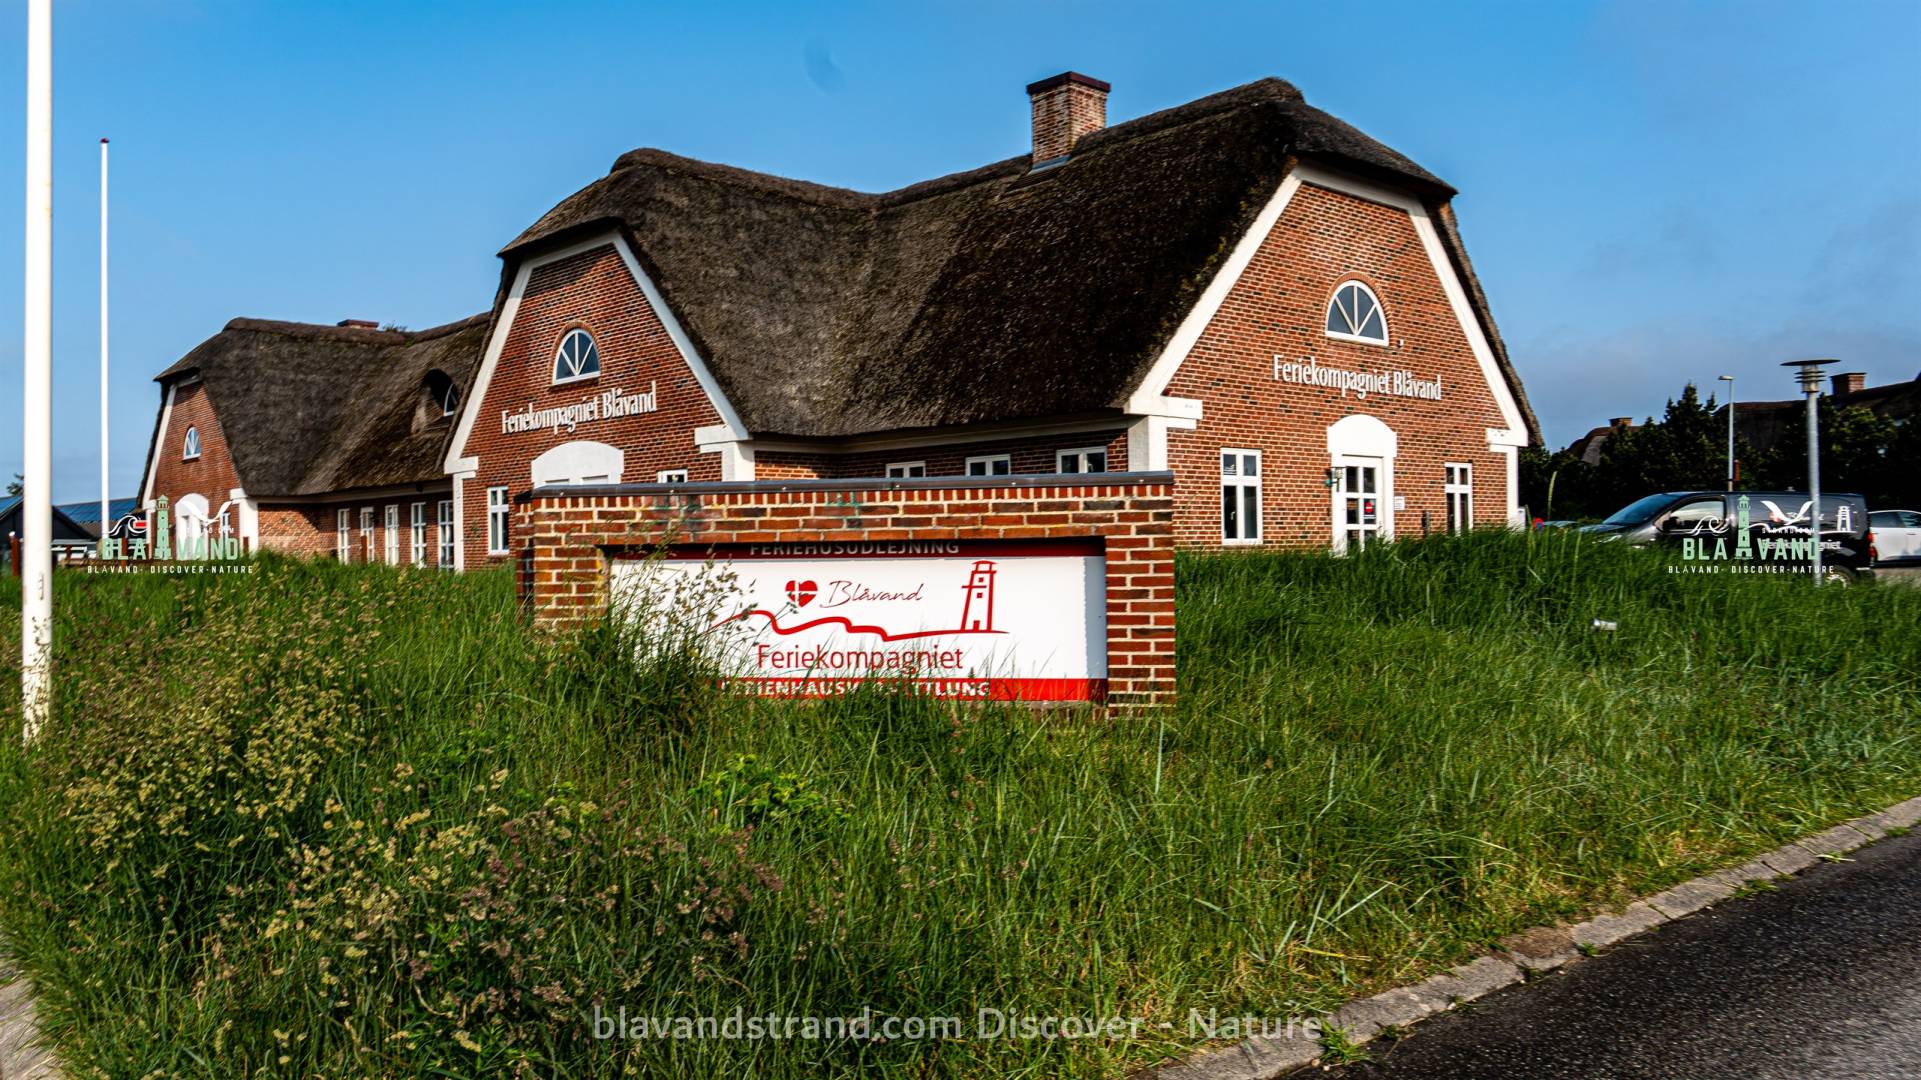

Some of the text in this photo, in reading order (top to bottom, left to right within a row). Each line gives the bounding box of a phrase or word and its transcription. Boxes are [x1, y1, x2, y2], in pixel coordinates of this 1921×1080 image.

[1273, 354, 1442, 401] Feriekompagniet Blåvand
[501, 380, 658, 436] Feriekompagniet Blåvand
[750, 540, 960, 556] FERIEHUSUDLEJNING
[819, 580, 925, 609] Blåvand
[757, 644, 963, 675] Feriekompagniet
